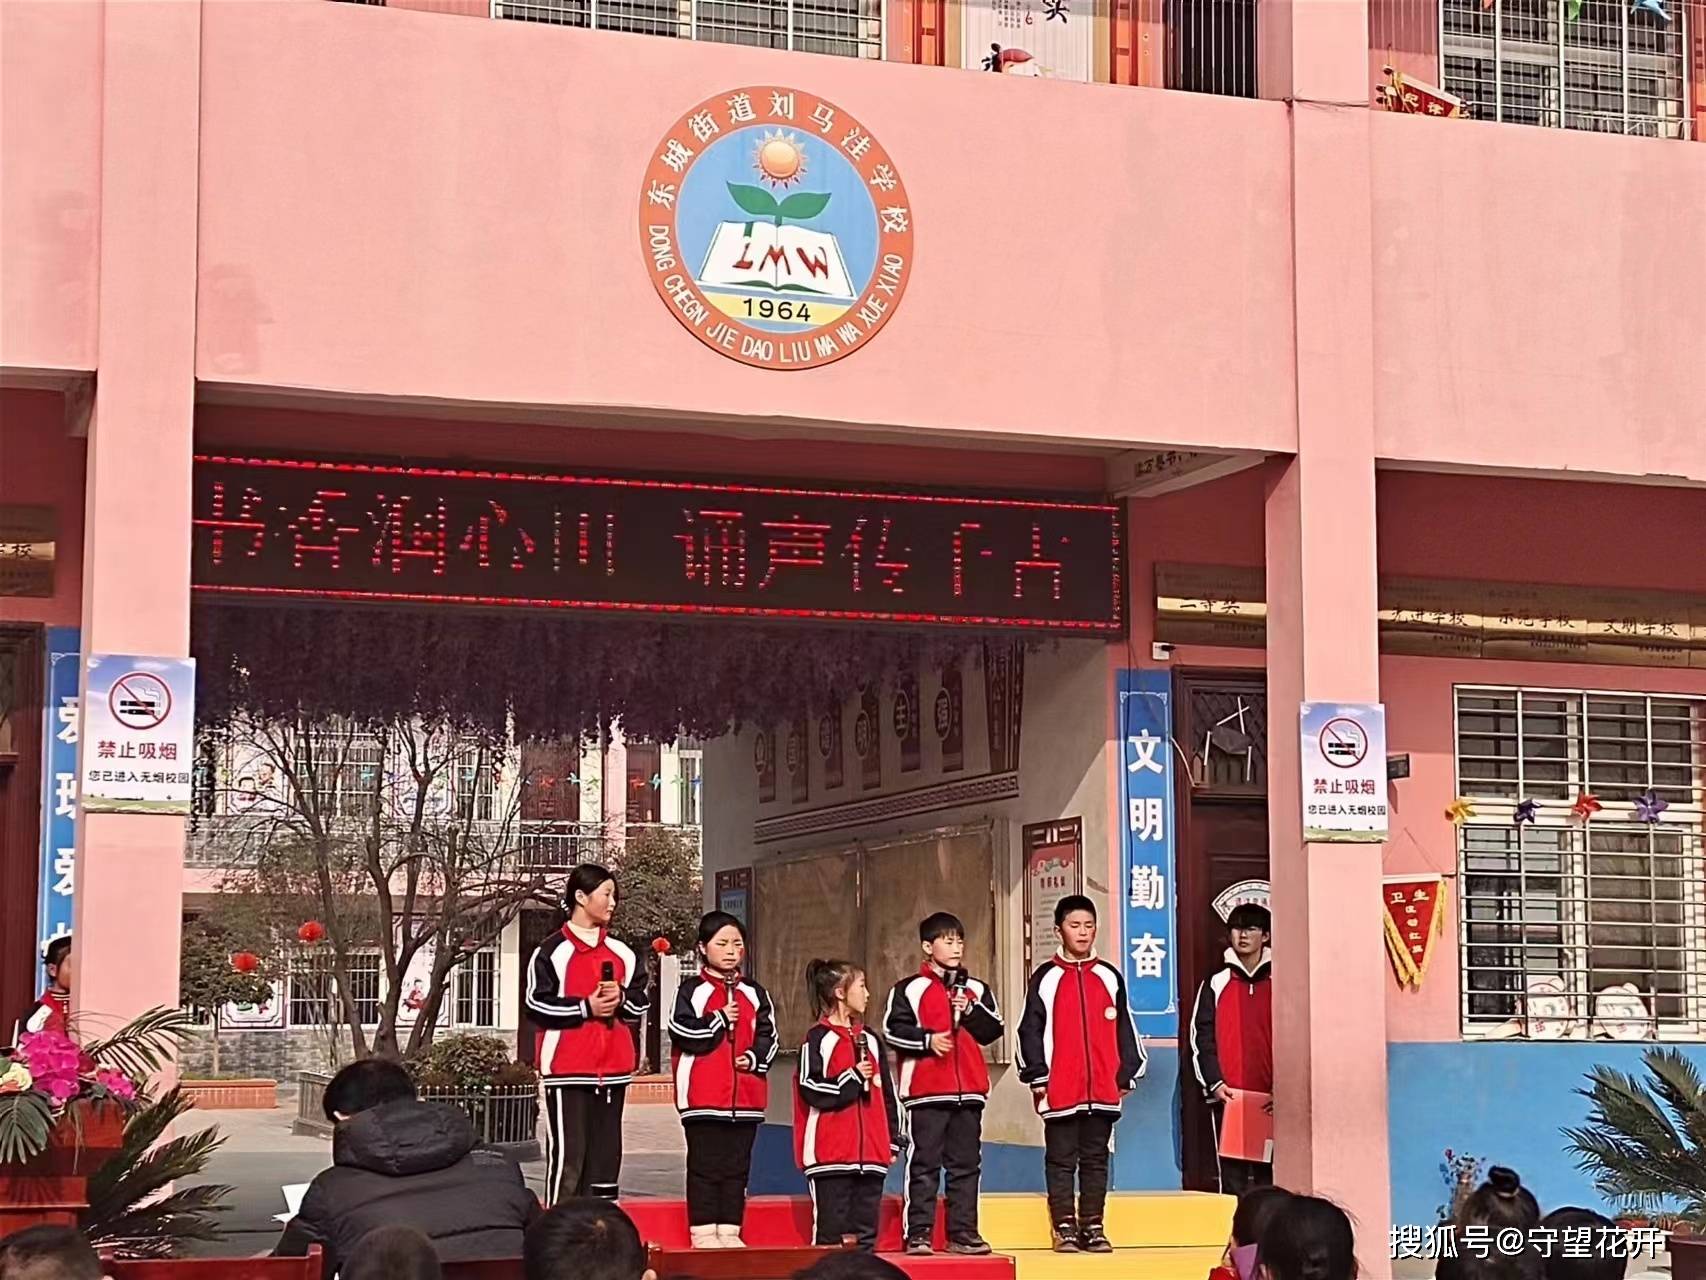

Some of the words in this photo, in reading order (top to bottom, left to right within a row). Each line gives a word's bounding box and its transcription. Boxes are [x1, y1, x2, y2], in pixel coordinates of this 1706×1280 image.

[647, 91, 909, 234] 东城街道刘马洼学校
[648, 224, 676, 272] DONG
[663, 274, 708, 327] CHEGN
[706, 320, 739, 349] JIE
[740, 335, 774, 361] DAO
[780, 342, 811, 363] LIU
[815, 336, 838, 358] MA
[836, 324, 862, 347] WA
[858, 295, 889, 328] XUE
[877, 253, 904, 297] XIAO
[743, 297, 812, 323] 1964
[98, 740, 177, 760] 禁止吸烟
[88, 770, 190, 784] 您已进入无烟校园
[1313, 778, 1376, 795] 禁止吸烟
[1308, 804, 1387, 816] 您已进入无烟校园
[1127, 729, 1167, 979] 文明勤奋
